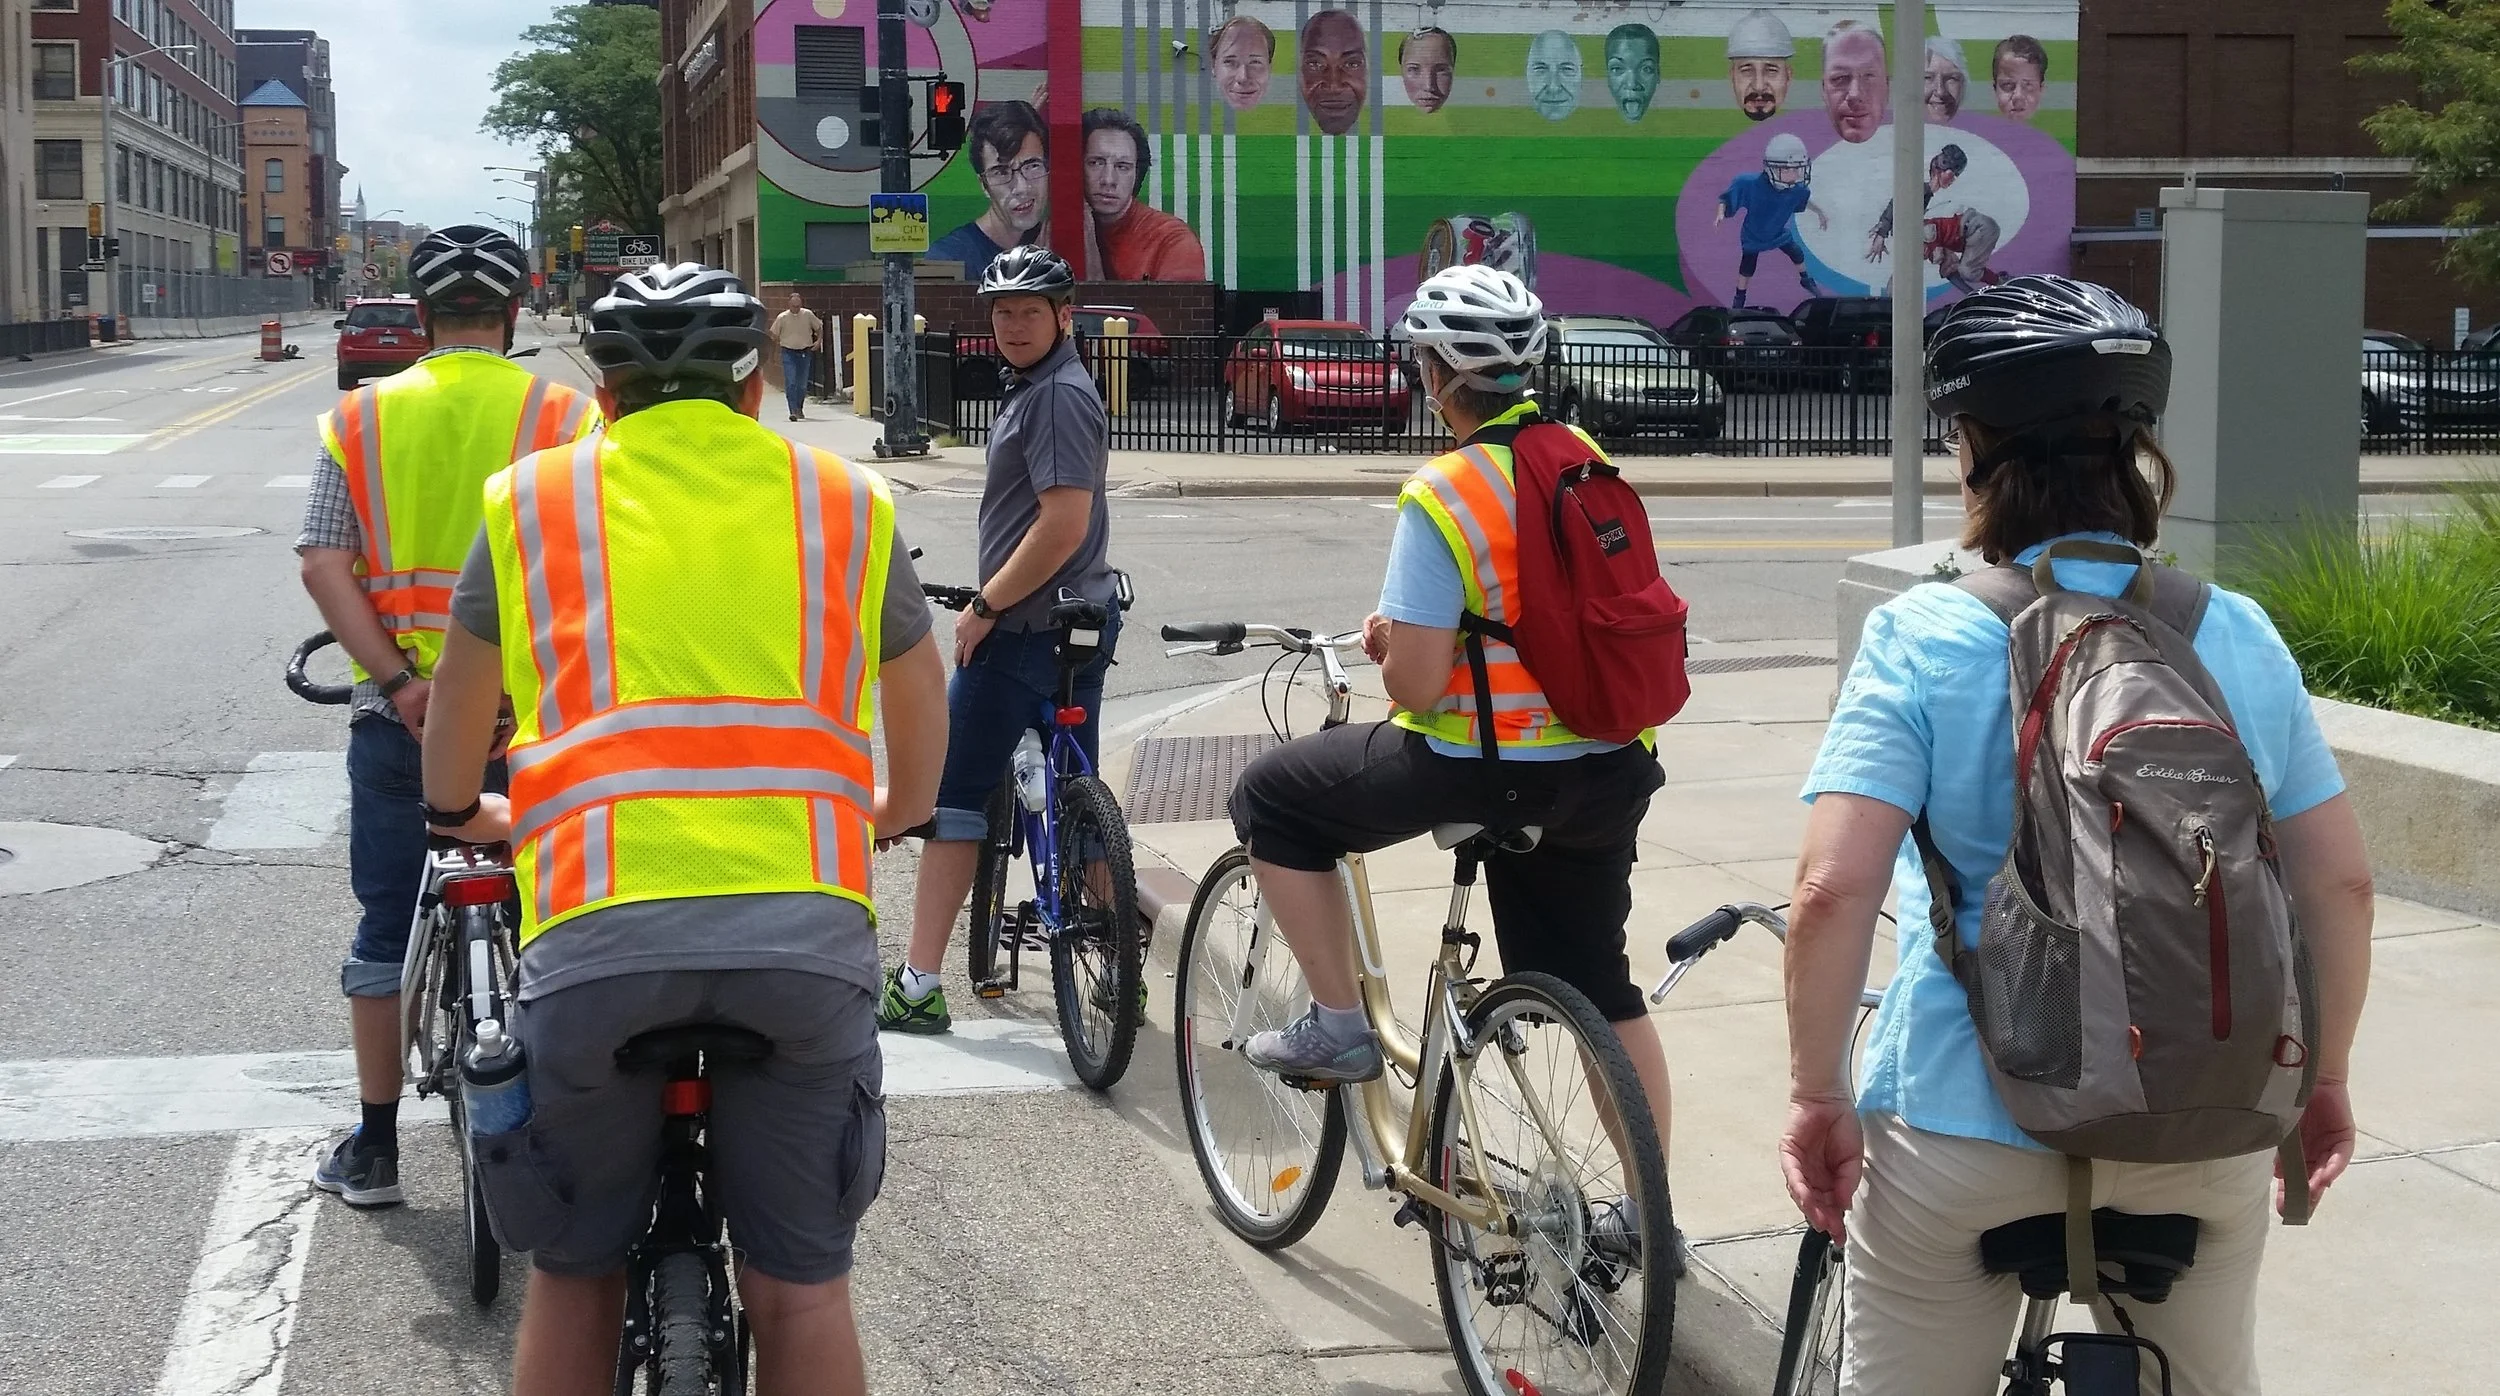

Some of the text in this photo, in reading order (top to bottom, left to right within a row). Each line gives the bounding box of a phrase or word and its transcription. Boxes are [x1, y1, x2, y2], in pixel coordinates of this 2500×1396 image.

[903, 225, 926, 234] CITY
[622, 257, 637, 265] BIKE
[639, 257, 657, 265] LANE
[2136, 763, 2239, 784] Eddie Bauer
[1050, 852, 1060, 893] KLEIN
